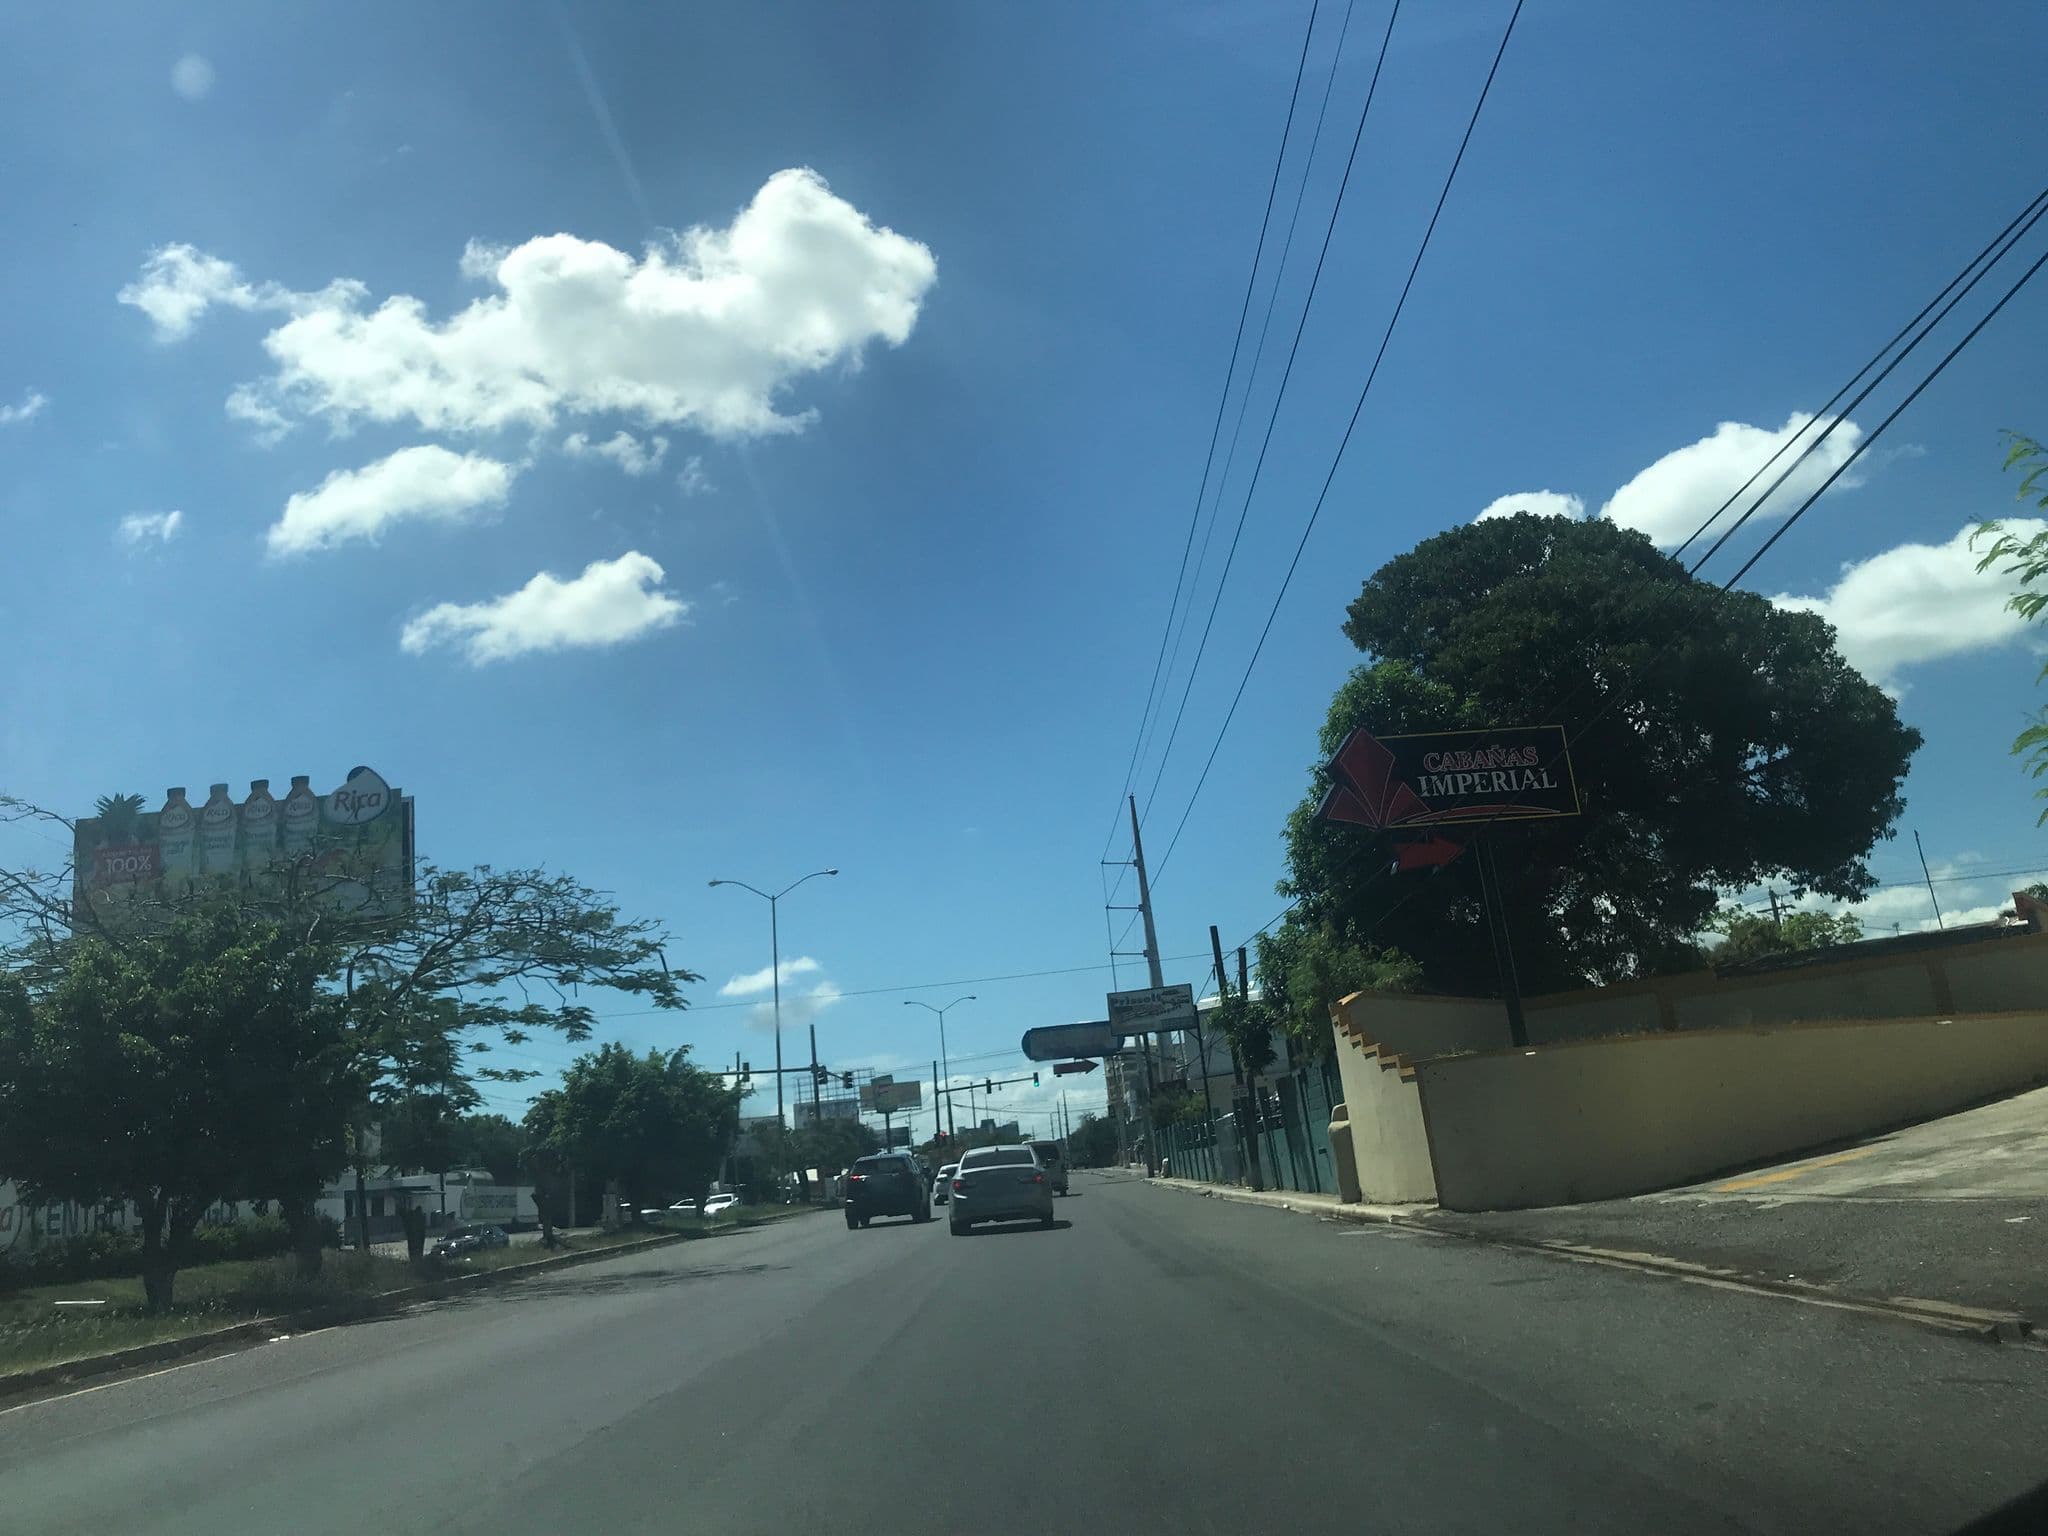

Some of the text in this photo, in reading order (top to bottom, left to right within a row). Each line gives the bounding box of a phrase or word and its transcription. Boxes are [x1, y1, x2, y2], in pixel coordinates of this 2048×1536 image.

[1423, 745, 1539, 772] CABAÑAS
[1417, 768, 1558, 797] IMPERIAL
[333, 789, 381, 817] Rica
[105, 855, 153, 873] 100%
